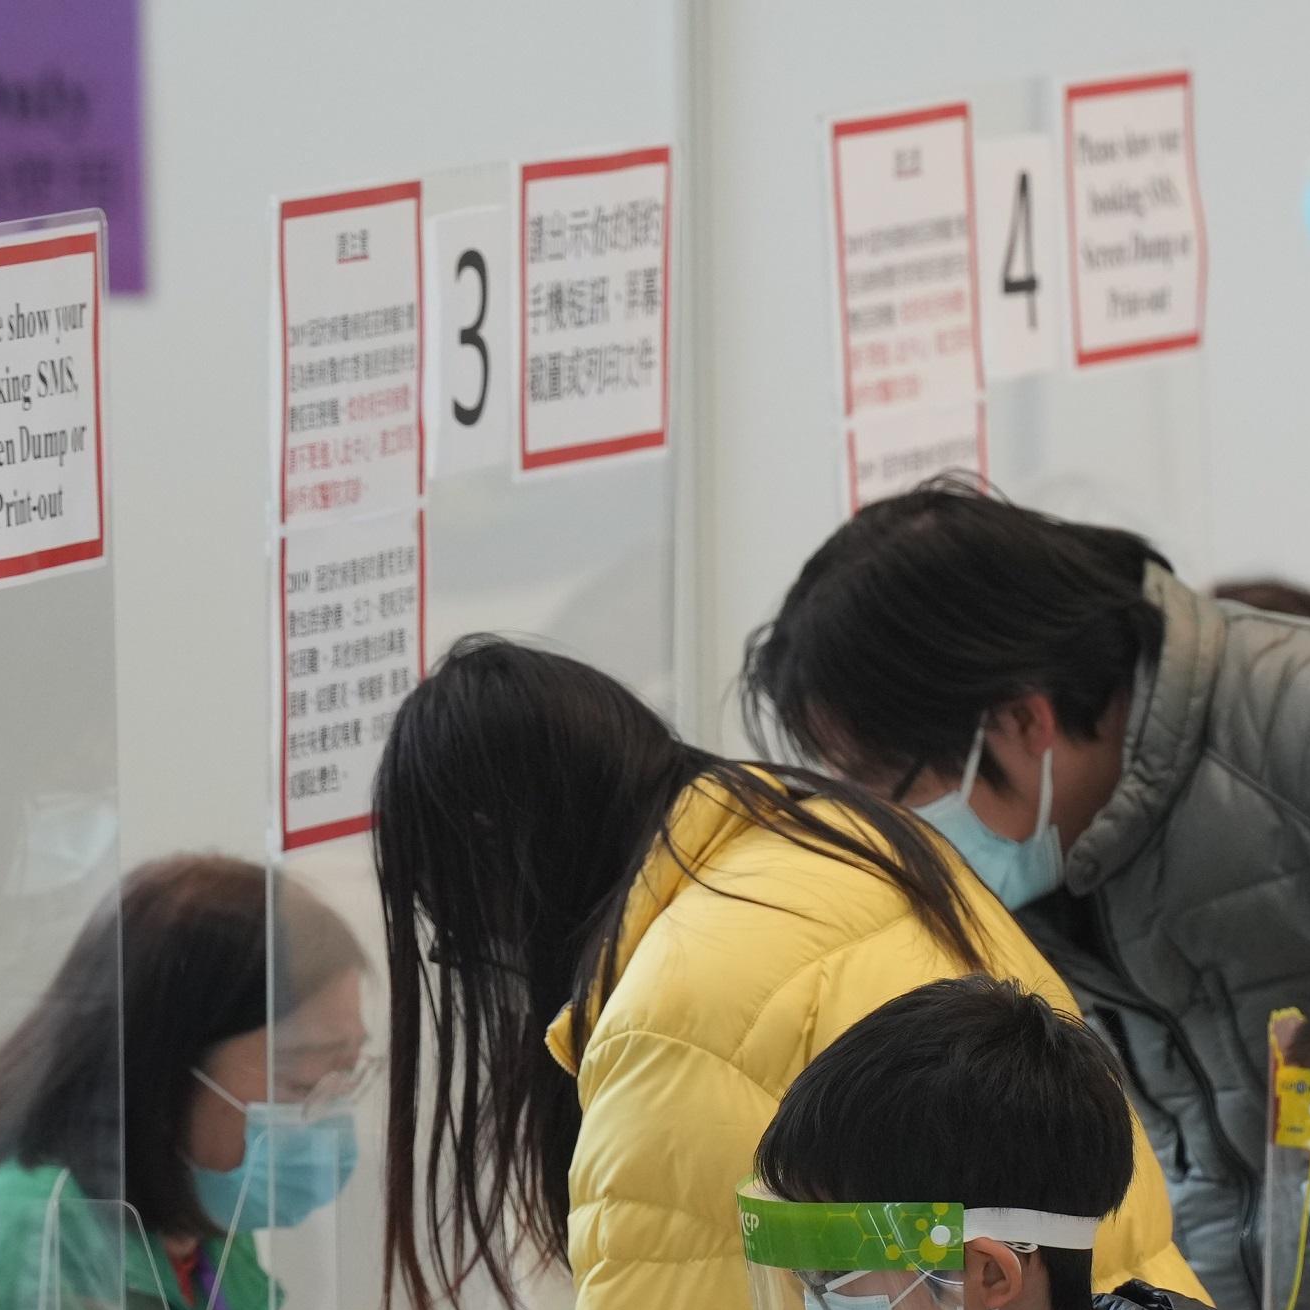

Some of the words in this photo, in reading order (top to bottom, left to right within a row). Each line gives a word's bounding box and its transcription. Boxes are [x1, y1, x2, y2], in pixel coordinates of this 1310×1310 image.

[1001, 169, 1039, 330] 4
[8, 303, 51, 341] show
[55, 303, 86, 344] your
[452, 248, 490, 427] 3
[19, 425, 68, 467] Dump
[71, 425, 87, 453] or
